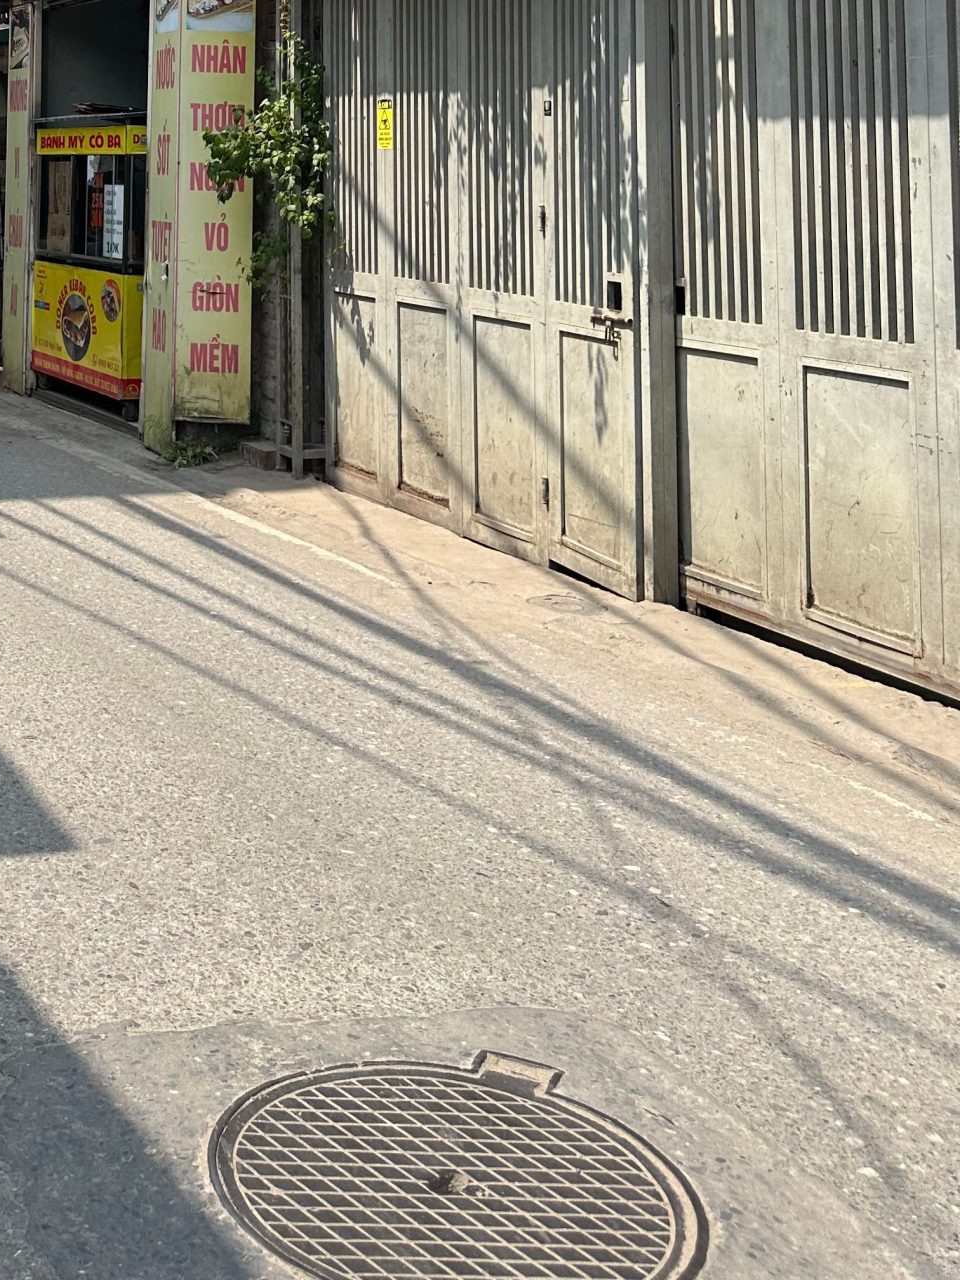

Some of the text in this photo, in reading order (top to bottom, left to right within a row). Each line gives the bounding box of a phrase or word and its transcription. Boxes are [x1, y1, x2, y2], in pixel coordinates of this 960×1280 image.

[156, 39, 176, 90] NƯỚC
[191, 39, 246, 74] NHÂN
[190, 101, 246, 133] THƠM
[41, 133, 65, 149] BÁNH
[89, 132, 104, 148] CÔ
[107, 135, 121, 148] BA
[156, 119, 171, 176] SỐT
[204, 212, 229, 252] VỎ
[192, 275, 239, 313] GIÒN
[190, 333, 239, 374] MỀM
